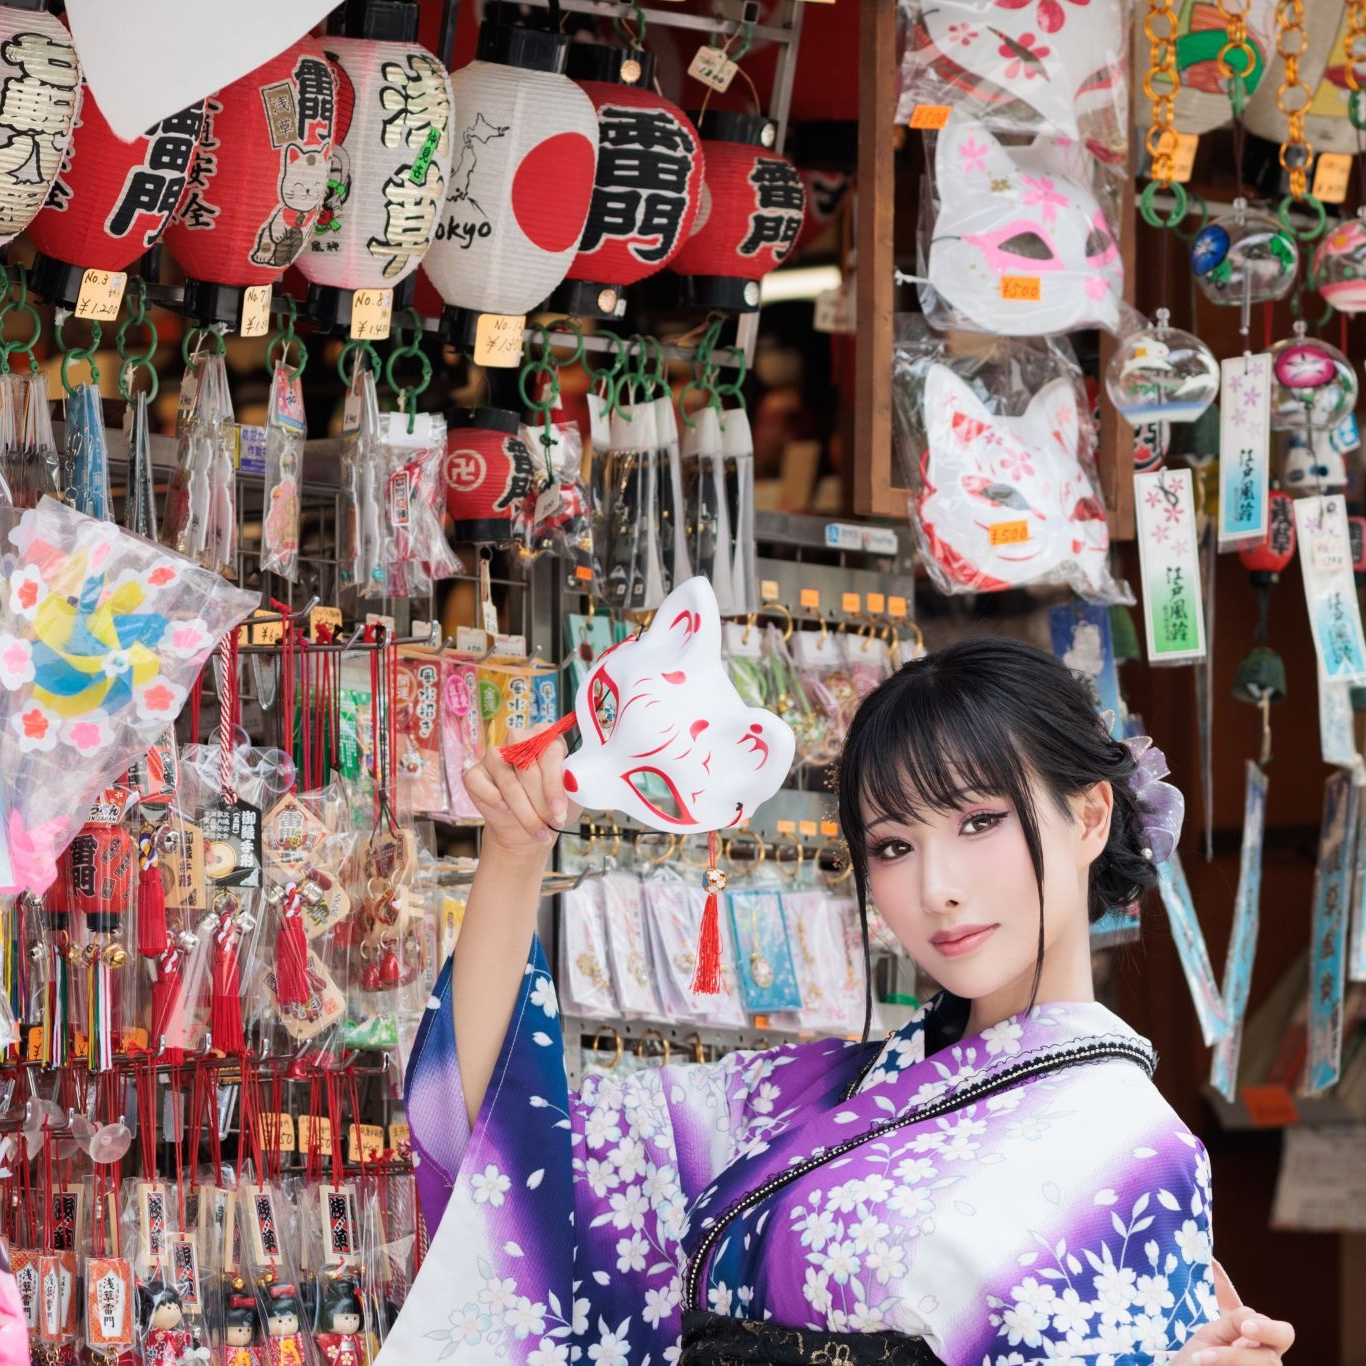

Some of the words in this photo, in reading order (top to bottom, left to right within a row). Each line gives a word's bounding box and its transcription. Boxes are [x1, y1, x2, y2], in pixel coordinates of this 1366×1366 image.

[273, 94, 293, 139] 浅草
[296, 59, 332, 140] 雷門
[578, 105, 693, 261] 雷門
[737, 157, 803, 259] 雷門
[435, 214, 492, 249] okyo
[84, 271, 109, 286] No.3
[356, 292, 383, 307] No.8
[1001, 280, 1039, 298] ¥500
[1237, 448, 1255, 523] 江戸風鈴
[990, 524, 1029, 543] ¥500
[1165, 565, 1188, 642] 江戸風鈴
[418, 665, 435, 738] 風水招き
[507, 678, 527, 729] 風水招
[102, 1277, 116, 1329] 浅草雷門
